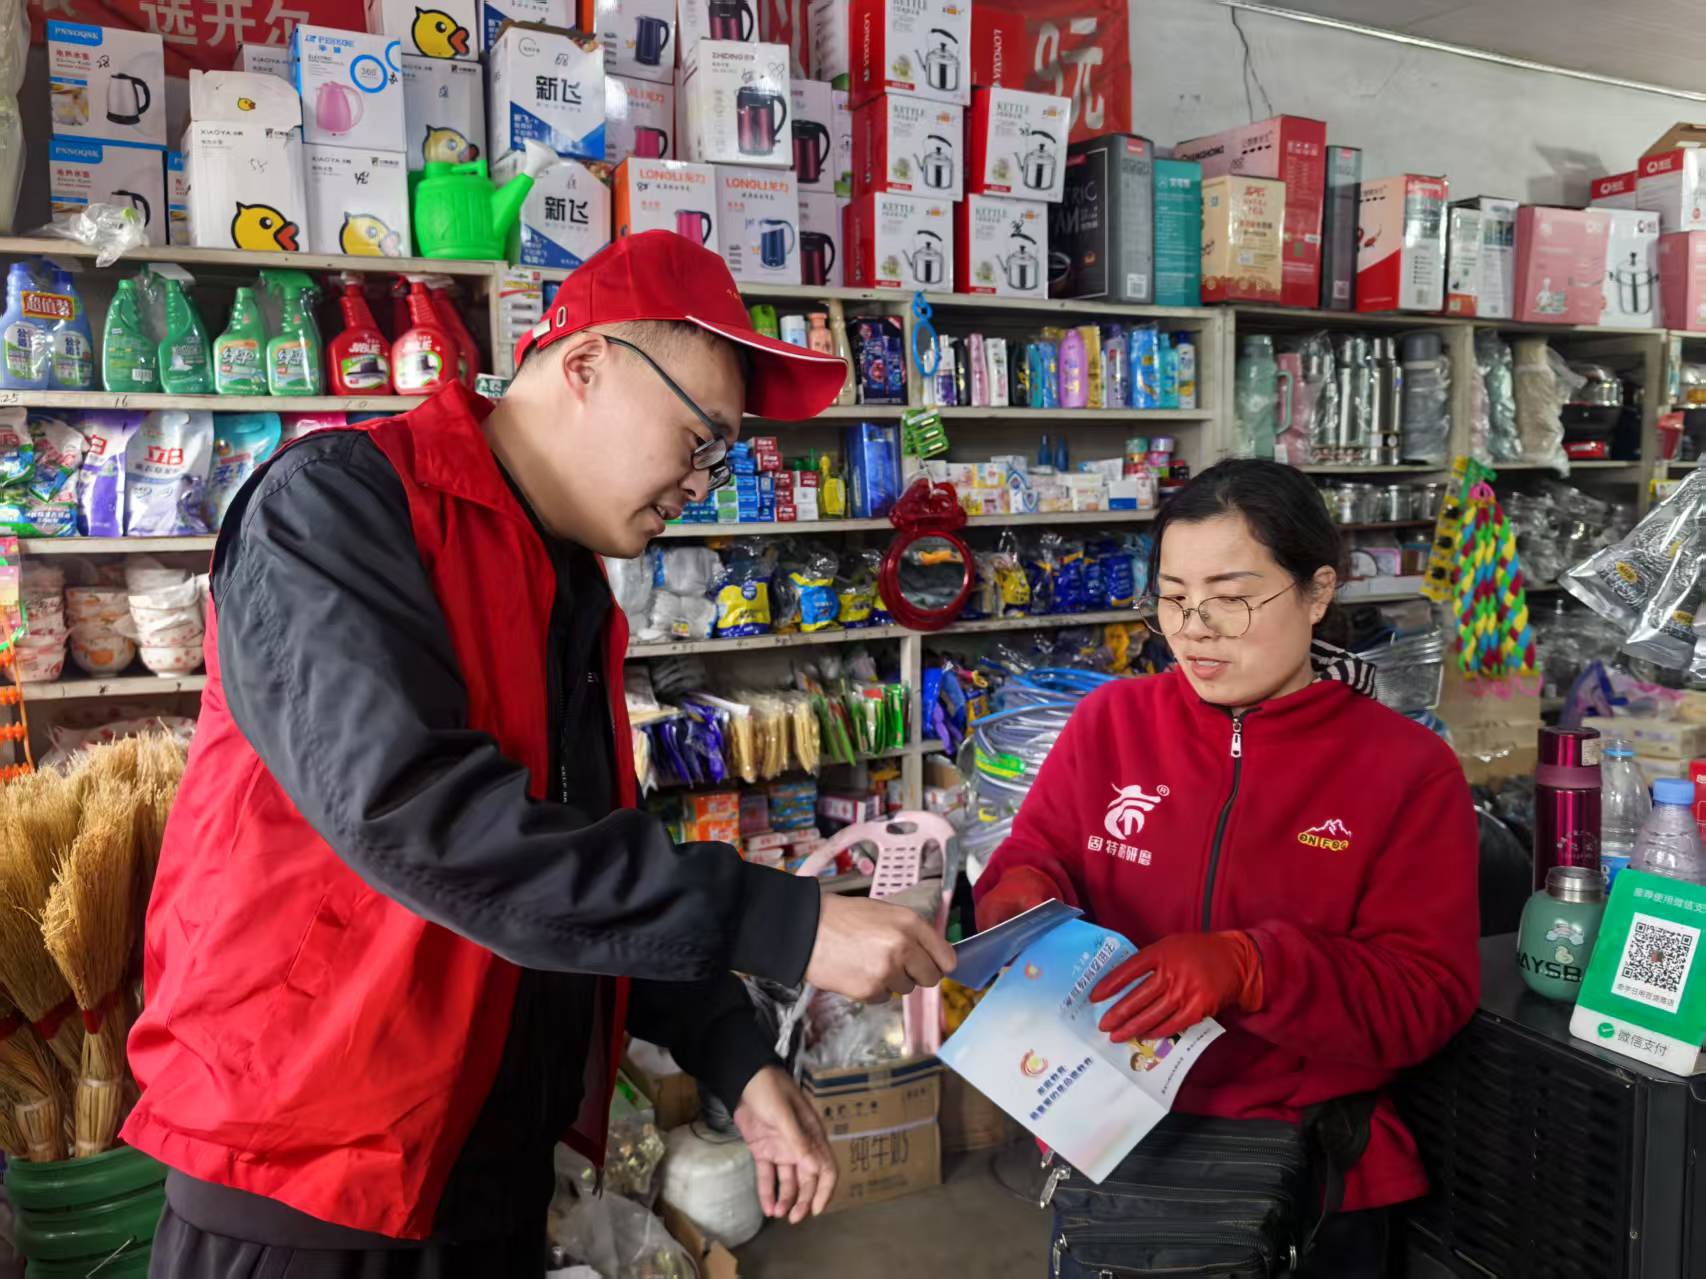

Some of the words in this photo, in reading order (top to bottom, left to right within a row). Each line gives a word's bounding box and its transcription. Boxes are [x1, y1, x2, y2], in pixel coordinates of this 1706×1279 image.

[536, 75, 583, 105] 新飞
[726, 177, 767, 191] LONGLI
[545, 196, 589, 225] 新飞
[1633, 887, 1706, 914] 推荐使用微信支
[1617, 1029, 1669, 1058] 微信支付
